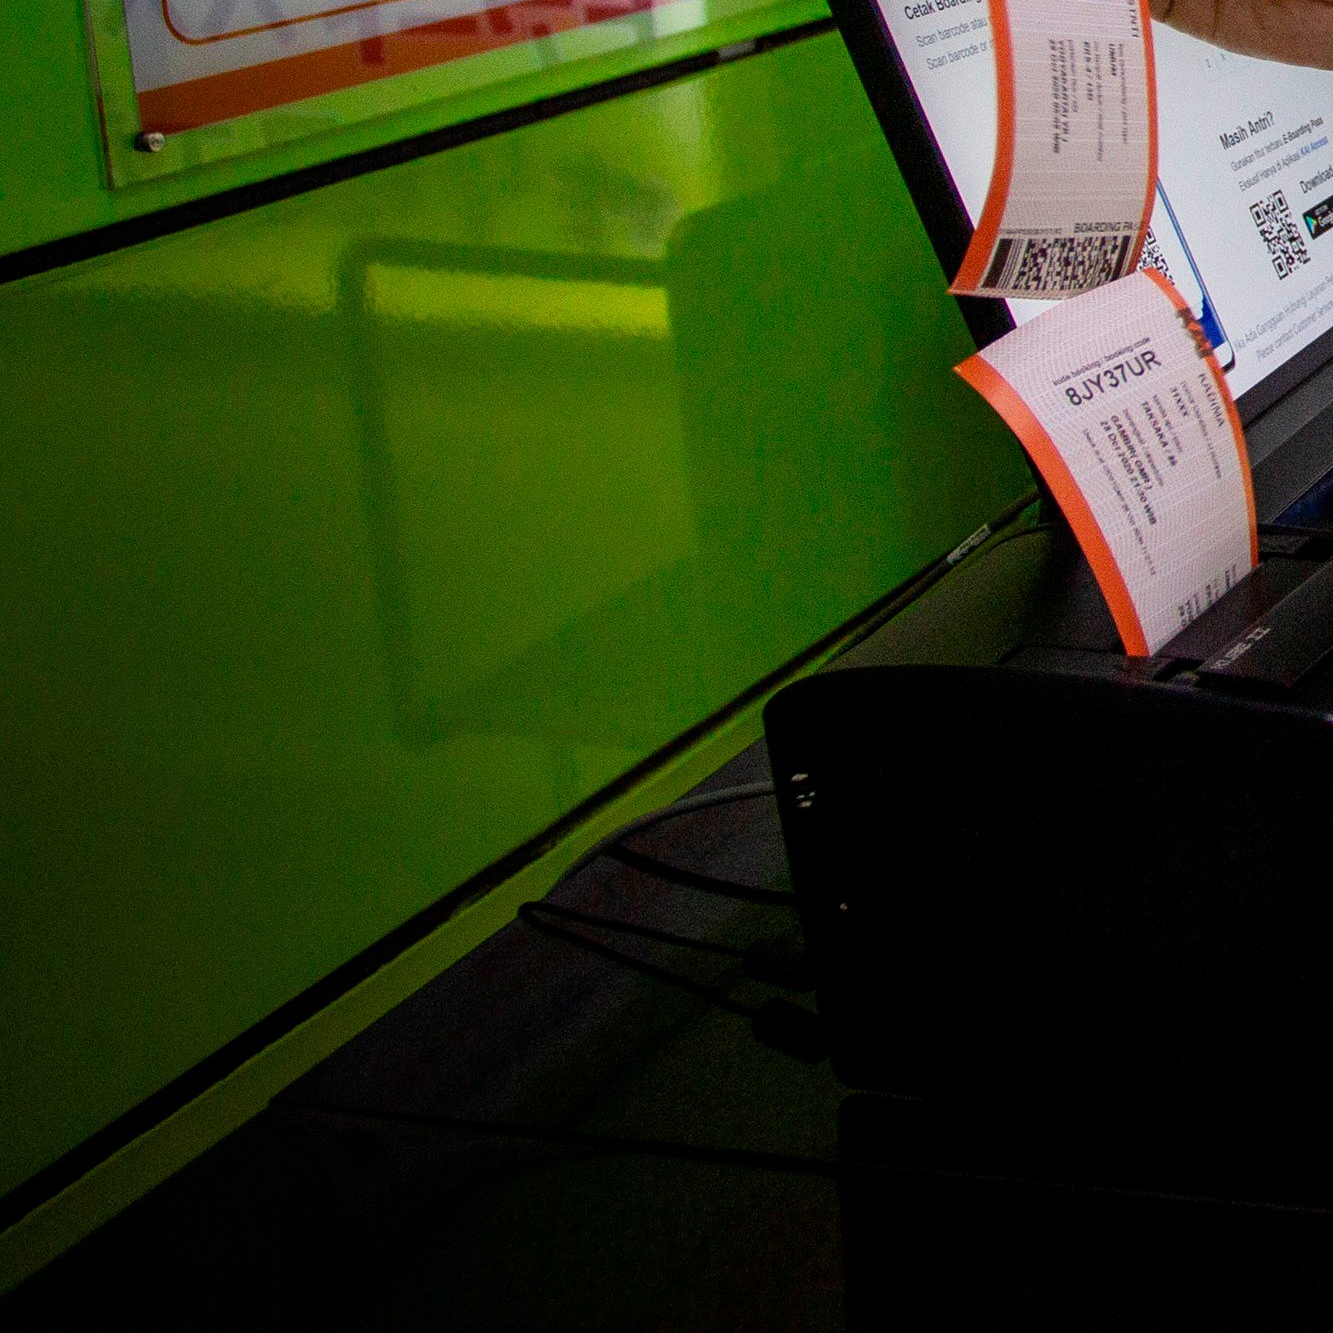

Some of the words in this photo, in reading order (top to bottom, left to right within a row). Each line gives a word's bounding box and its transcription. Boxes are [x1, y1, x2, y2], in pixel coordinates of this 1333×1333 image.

[916, 27, 942, 48] Scan
[939, 19, 970, 41] barcode
[926, 49, 950, 70] Scan
[948, 40, 979, 62] barcode
[1219, 125, 1249, 151] Masih
[1248, 110, 1275, 136] Antri?
[1073, 221, 1122, 234] BOARDING
[1064, 350, 1162, 406] 8JY37UR
[1141, 400, 1169, 449] TAKSAKA
[1143, 504, 1158, 526] WIB
